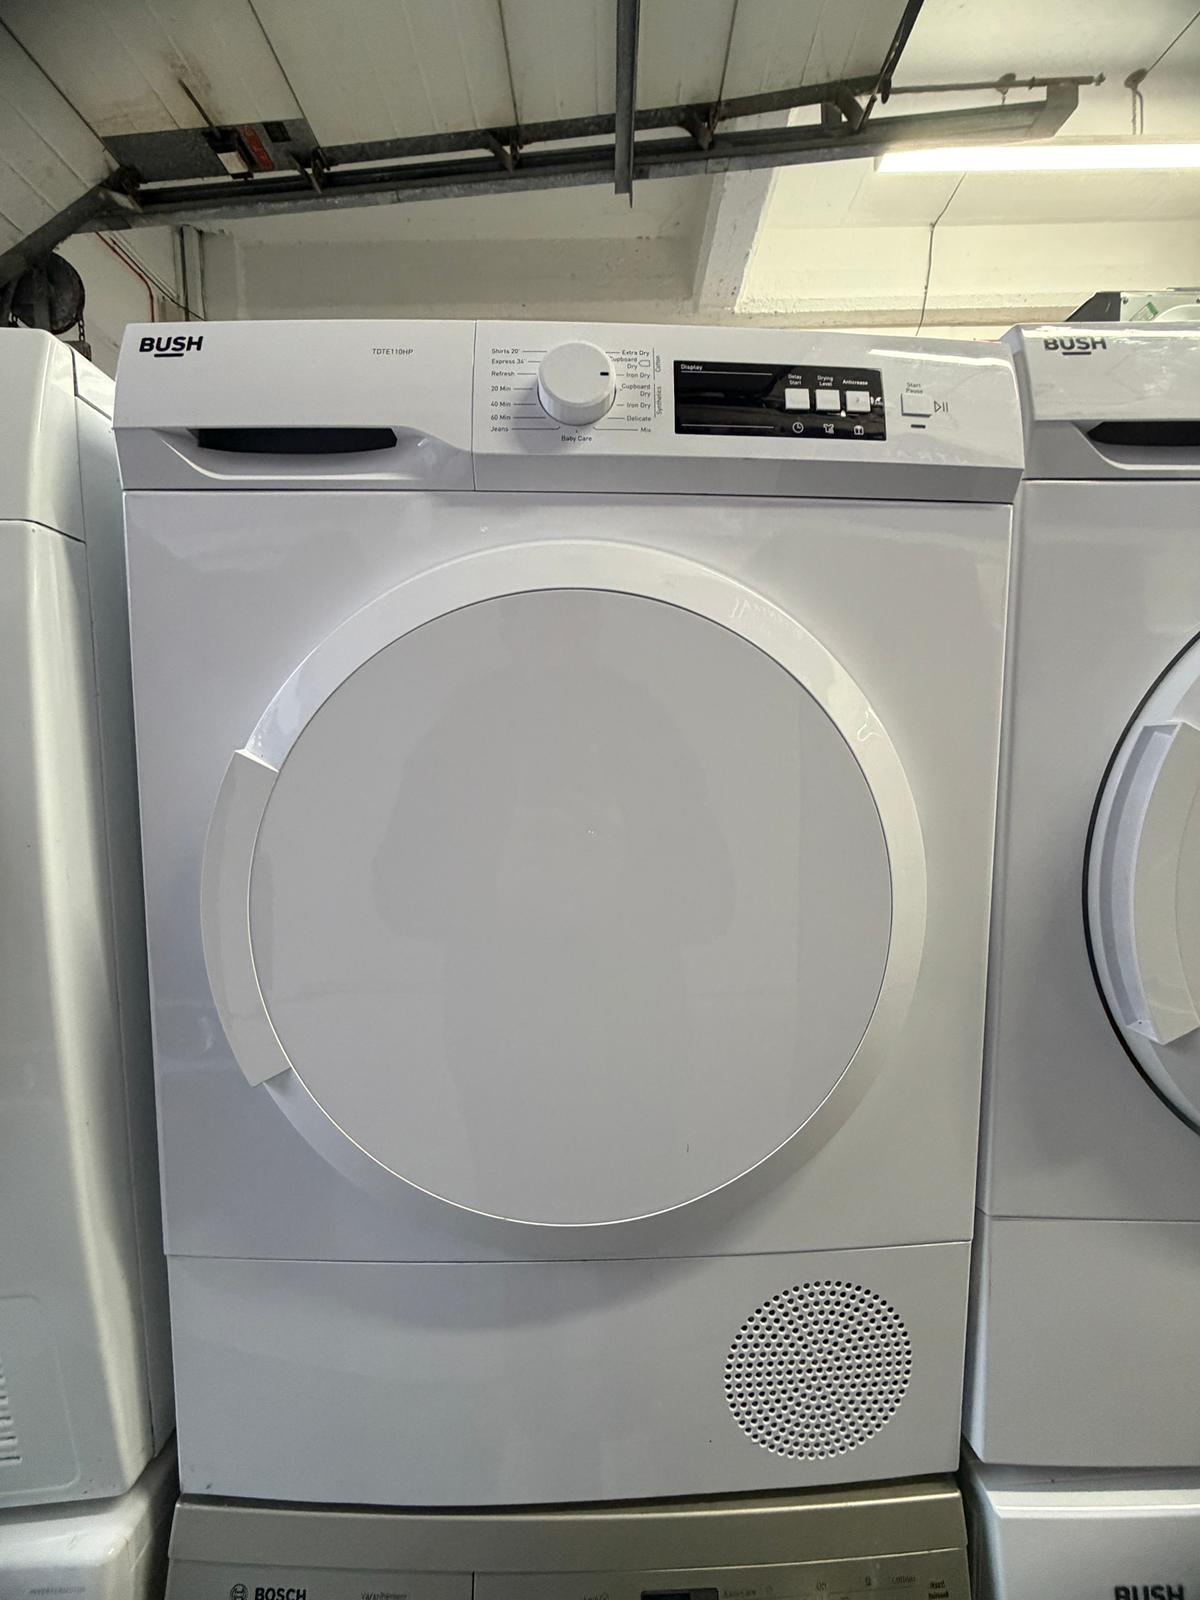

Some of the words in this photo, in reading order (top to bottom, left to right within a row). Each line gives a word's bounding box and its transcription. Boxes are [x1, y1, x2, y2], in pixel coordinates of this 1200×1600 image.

[139, 336, 203, 352] BUSH
[1044, 336, 1107, 351] BUSH
[680, 363, 703, 371] Display
[621, 383, 651, 391] Cupboard
[640, 390, 651, 398] Dry
[640, 402, 651, 410] Dry
[255, 1587, 306, 1600] BOSCH
[1114, 1584, 1184, 1600] BUSH
